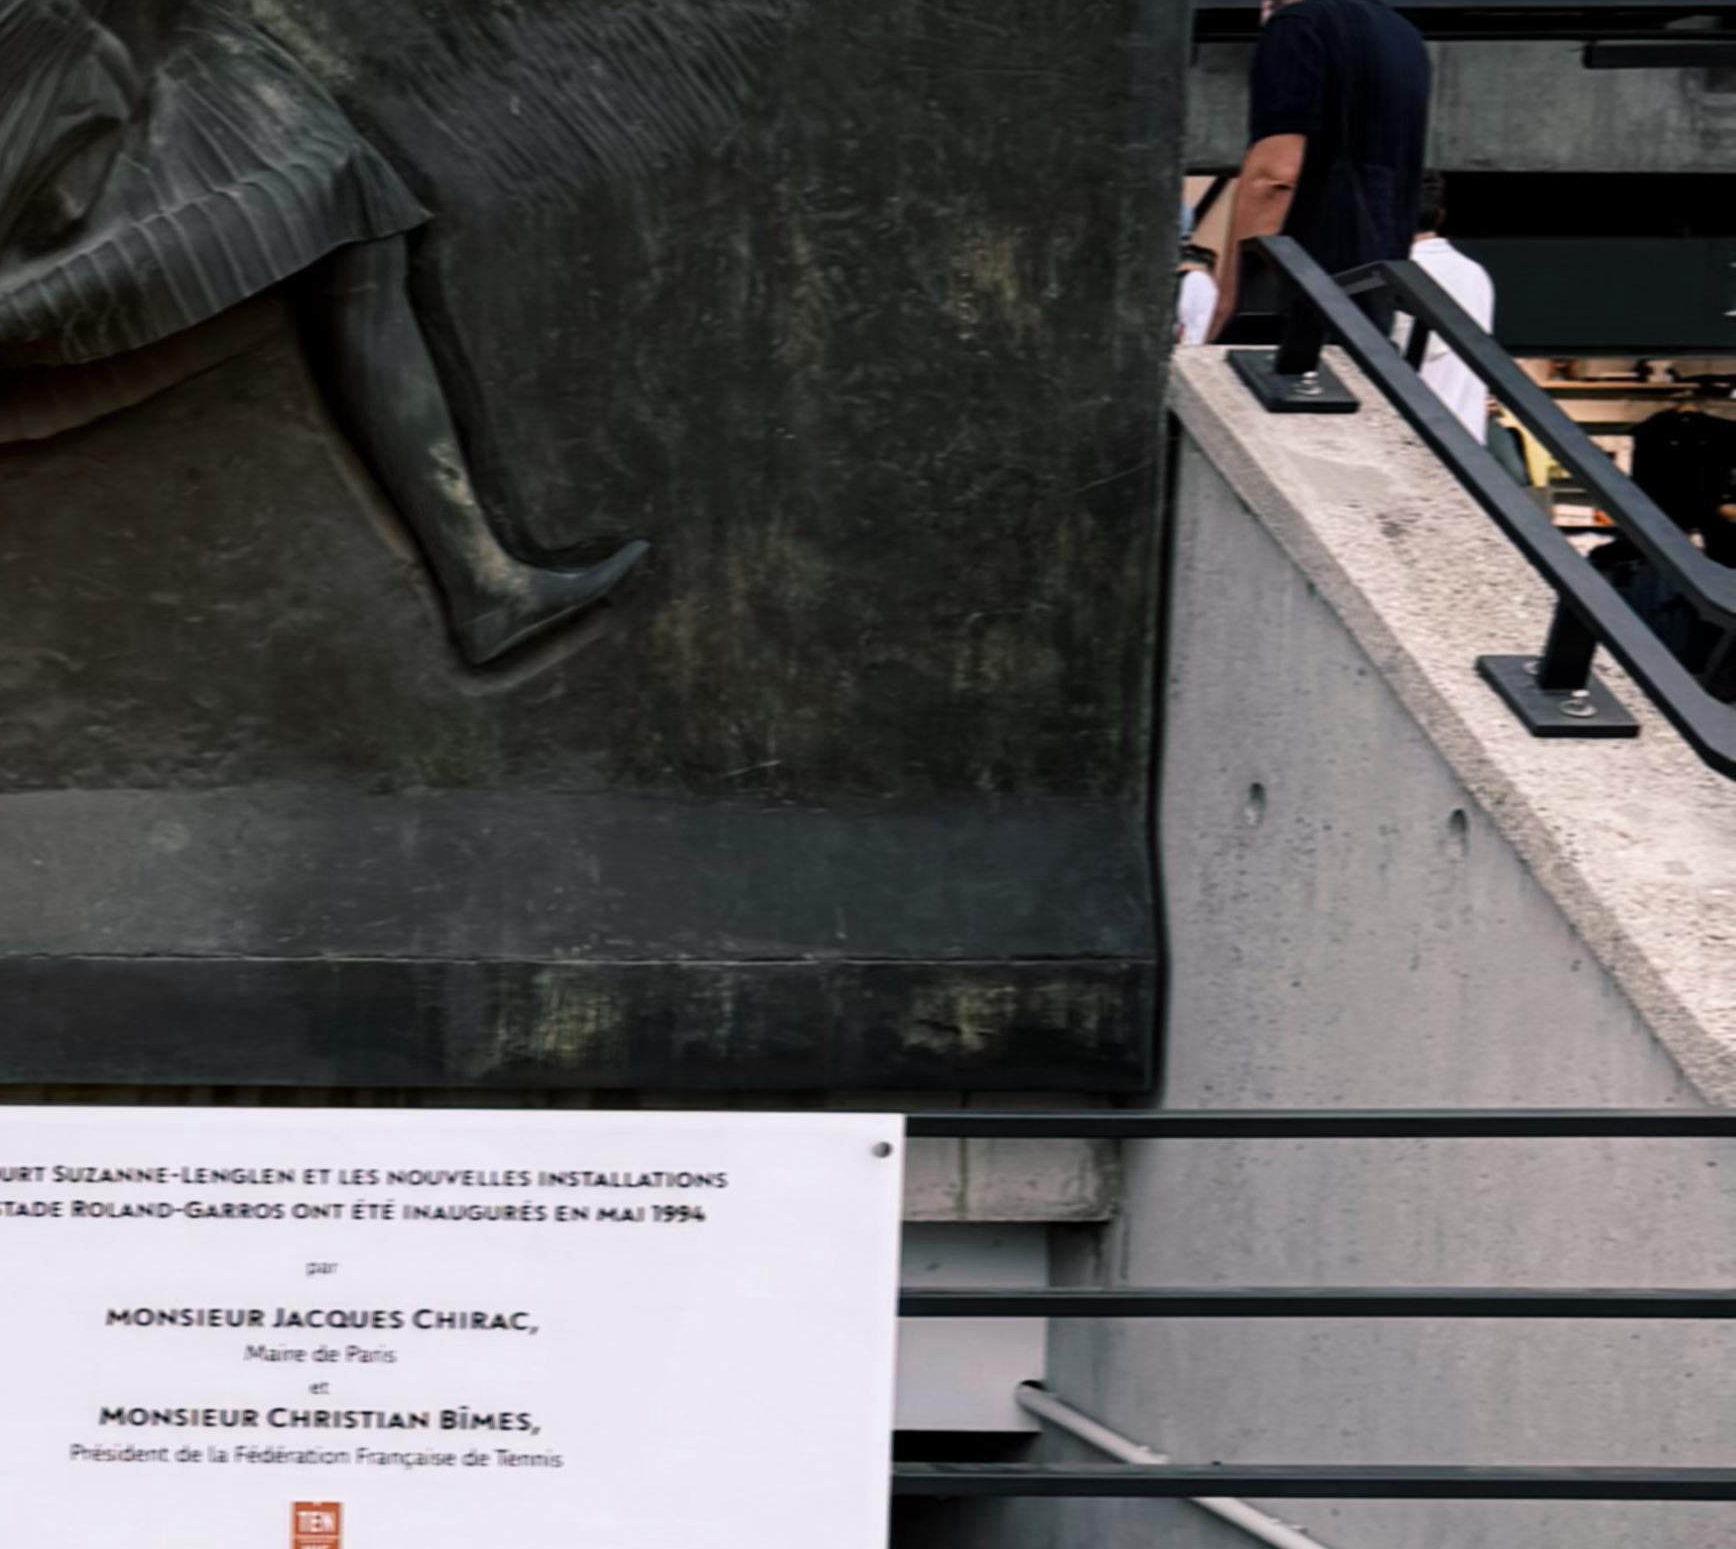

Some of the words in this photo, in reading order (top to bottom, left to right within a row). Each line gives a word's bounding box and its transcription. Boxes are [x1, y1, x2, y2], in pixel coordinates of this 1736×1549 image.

[51, 1165, 297, 1186] SUZANNE-LENGLEN
[302, 1167, 332, 1185] ET
[338, 1168, 379, 1186] LES
[385, 1169, 532, 1187] NOUVELLES
[538, 1170, 729, 1189] INSTALLATIONS
[70, 1200, 286, 1220] ROLAND-GARROS
[291, 1202, 345, 1220] ONT
[350, 1198, 396, 1221] ÉTÉ
[402, 1199, 548, 1222] INAUGURÉS
[555, 1204, 590, 1222] EN
[595, 1205, 646, 1223] MAI
[651, 1204, 707, 1223] 1994
[306, 1261, 339, 1277] par
[105, 1307, 266, 1328] MONSIEUR
[271, 1307, 405, 1330] JACQUES
[412, 1308, 540, 1335] CHIRAC,
[243, 1344, 308, 1364] Maire
[312, 1344, 341, 1364] de
[344, 1344, 398, 1364] Paris
[308, 1380, 331, 1396] et
[98, 1406, 260, 1428] MONSIEUR
[266, 1406, 431, 1429] CHRISTIAN
[69, 1443, 168, 1463] Président
[173, 1443, 202, 1463] de
[207, 1443, 230, 1464] la
[234, 1444, 351, 1465] Fédération
[355, 1445, 456, 1471] Française
[460, 1447, 492, 1467] de
[495, 1448, 563, 1468] Tennis
[295, 1510, 336, 1533] TEN
